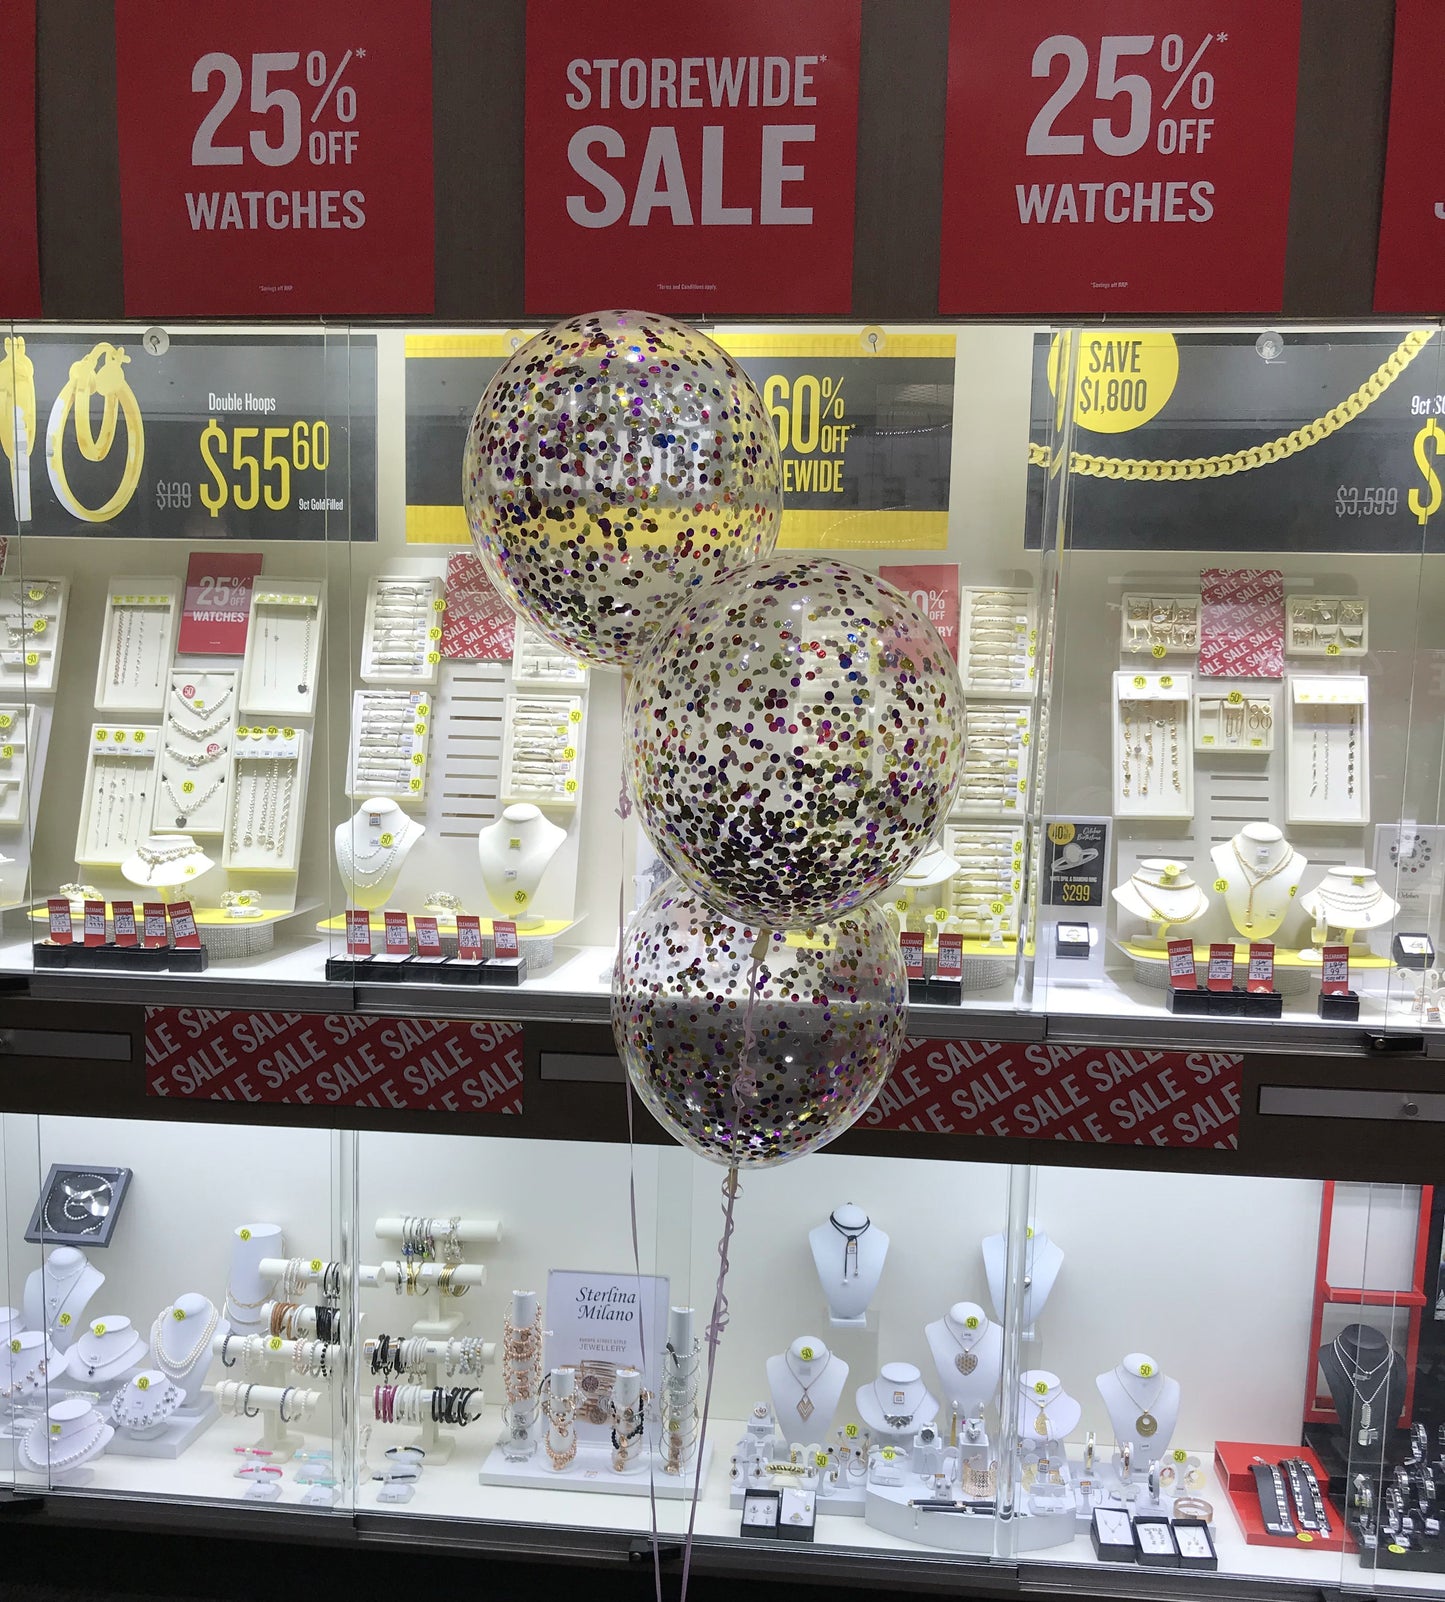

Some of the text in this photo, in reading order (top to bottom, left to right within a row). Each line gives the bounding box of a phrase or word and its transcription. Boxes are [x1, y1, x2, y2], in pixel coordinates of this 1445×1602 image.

[1156, 117, 1214, 155] OFF
[309, 132, 360, 165] OFF
[566, 124, 816, 228] SALE
[185, 190, 366, 231] WATCHES
[1015, 181, 1215, 225] WATCHES
[1089, 340, 1141, 374] SAVE
[208, 392, 276, 415] Double Hoops
[1080, 376, 1147, 415] $1,800
[1411, 395, 1431, 415] 9ct
[783, 459, 845, 493] EWIDE
[298, 498, 344, 511] 9ct Gold Filled
[1335, 485, 1398, 518] $3,599
[460, 563, 484, 583] SALE
[455, 582, 479, 602] SALE
[474, 587, 498, 606] SALE
[1213, 578, 1240, 599] SALE
[1236, 582, 1262, 603] SALE
[1257, 587, 1283, 607] SALE
[229, 597, 245, 606] OFF
[449, 601, 473, 621] SALE
[1210, 598, 1236, 618] SALE
[193, 611, 244, 622] WATCHES
[469, 606, 494, 625] SALE
[487, 610, 512, 629] SALE
[929, 611, 945, 620] OFF
[1254, 606, 1280, 627] SALE
[443, 620, 468, 640] SALE
[463, 625, 488, 645] SALE
[483, 628, 508, 648] SALE
[1227, 622, 1254, 643] SALE
[1249, 627, 1276, 647] SALE
[1201, 638, 1228, 659] SALE
[1223, 642, 1250, 663] SALE
[1246, 646, 1273, 667] SALE
[1063, 883, 1090, 902] $299
[171, 1036, 237, 1094] SALE
[257, 1029, 327, 1089] SALE
[403, 1036, 473, 1096] SALE
[316, 1042, 385, 1101] SALE
[952, 1059, 1026, 1120] SALE
[1109, 1068, 1187, 1130] SALE
[1013, 1074, 1090, 1135] SALE
[576, 1286, 636, 1304] Sterlina
[577, 1304, 634, 1322] Milano
[580, 1343, 626, 1352] JEWELLERY
